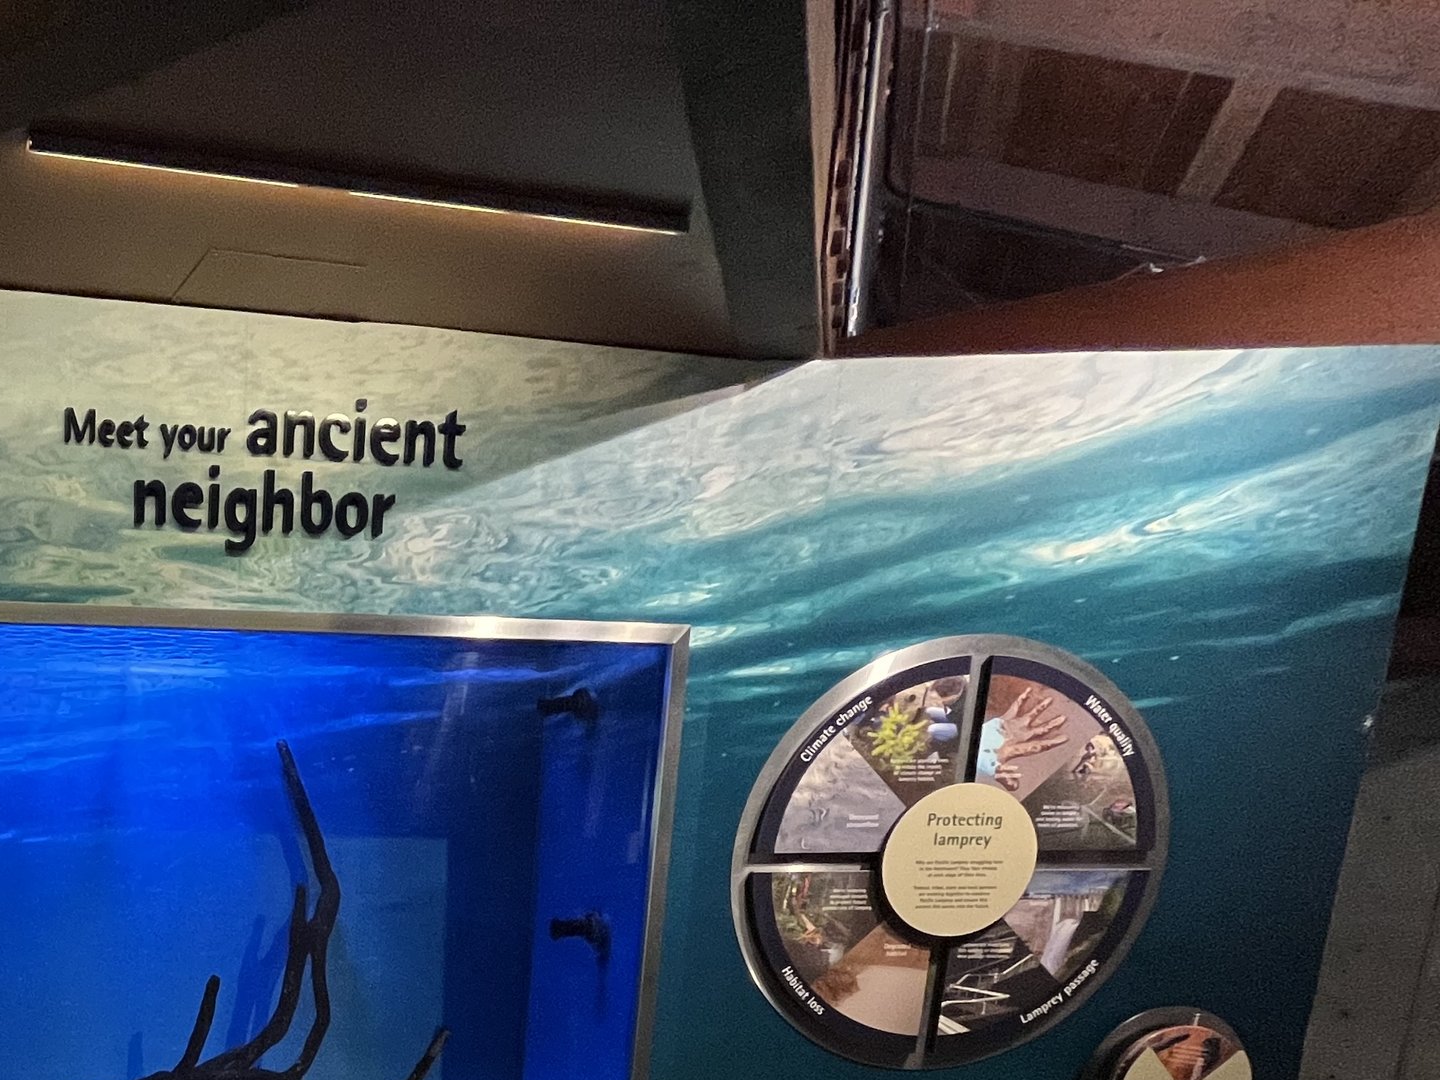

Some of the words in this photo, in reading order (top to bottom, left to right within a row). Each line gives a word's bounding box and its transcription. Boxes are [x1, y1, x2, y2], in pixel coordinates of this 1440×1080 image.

[63, 406, 150, 448] Meet
[160, 421, 232, 459] your
[247, 397, 467, 469] ancient
[133, 465, 396, 556] neighbor
[799, 725, 837, 762] Climate
[835, 695, 874, 727] change
[1084, 694, 1113, 723] Water
[1108, 722, 1135, 757] quality
[927, 813, 1003, 829] Protecting
[933, 832, 992, 849] lamprey
[781, 965, 810, 1001] Habitat
[806, 996, 826, 1016] loss
[1020, 993, 1064, 1024] Lamprey
[1063, 959, 1100, 997] passage
